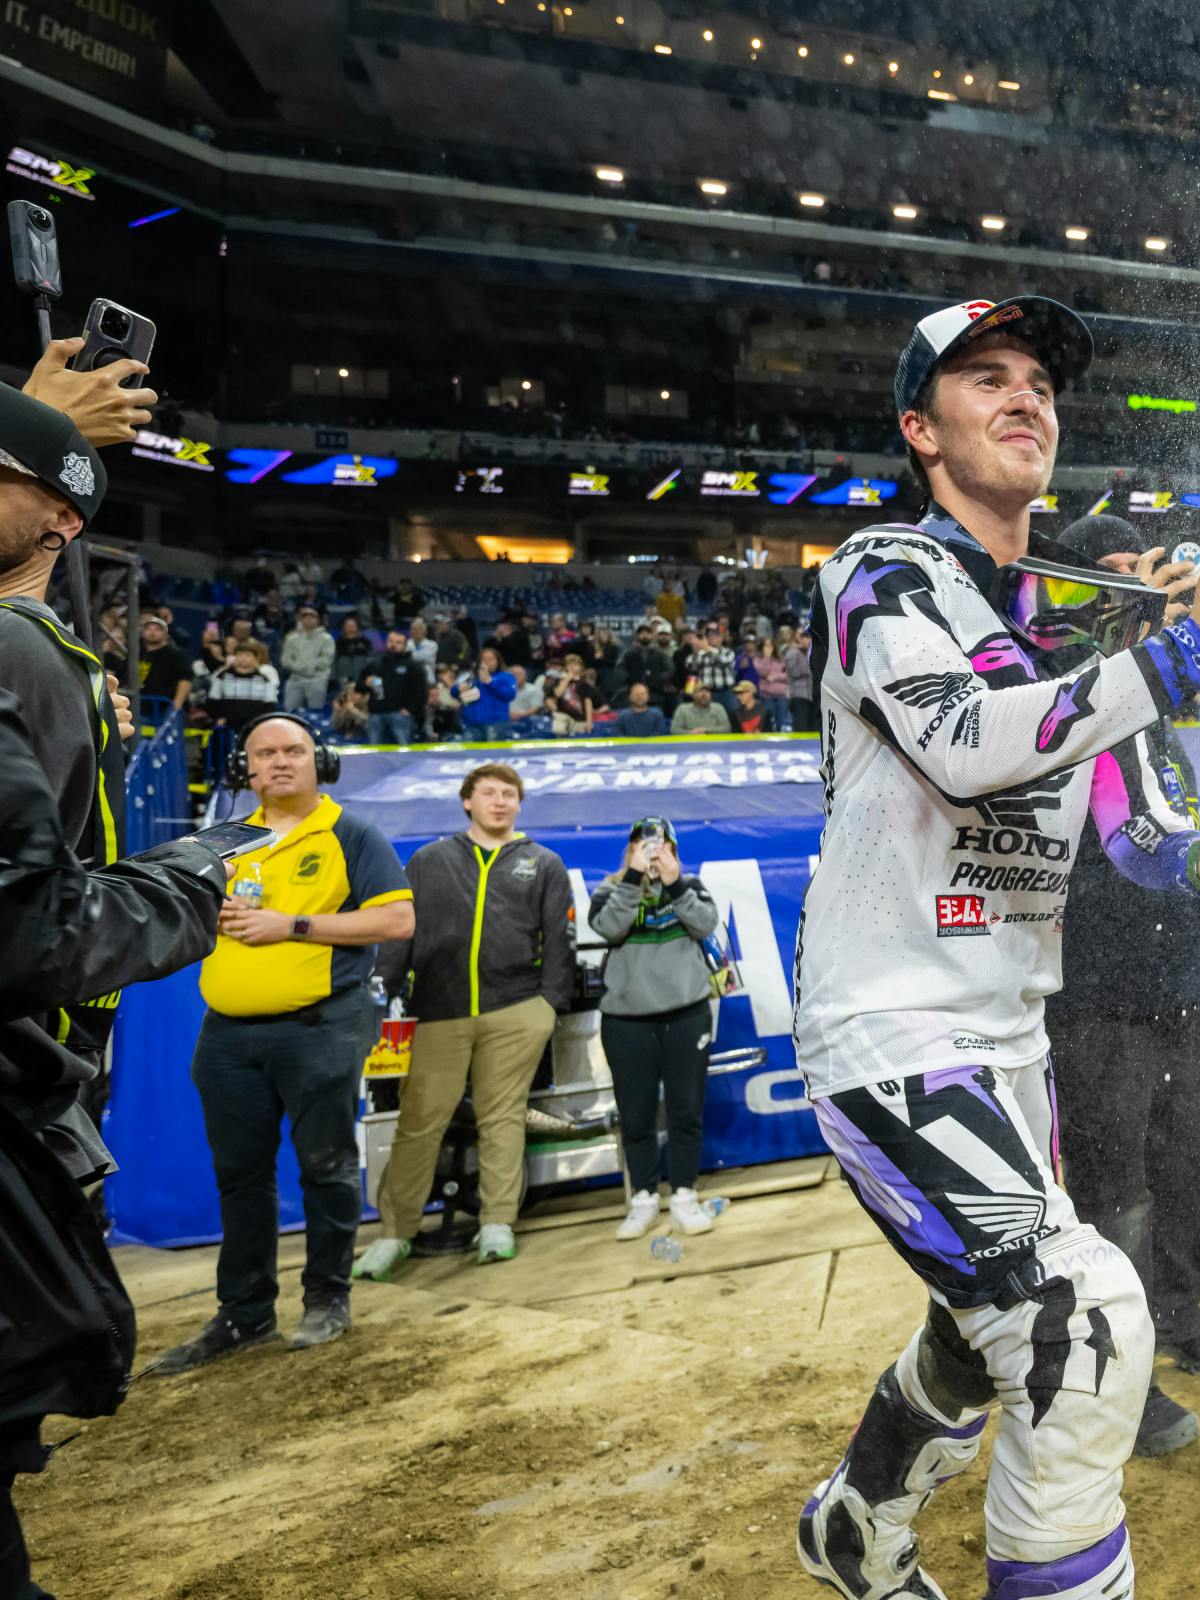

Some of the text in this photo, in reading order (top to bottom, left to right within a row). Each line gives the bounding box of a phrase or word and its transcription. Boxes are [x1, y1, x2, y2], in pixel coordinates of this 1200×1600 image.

[38, 14, 137, 79] EMPEROR!
[136, 430, 211, 465] SMX
[701, 471, 759, 491] SMX
